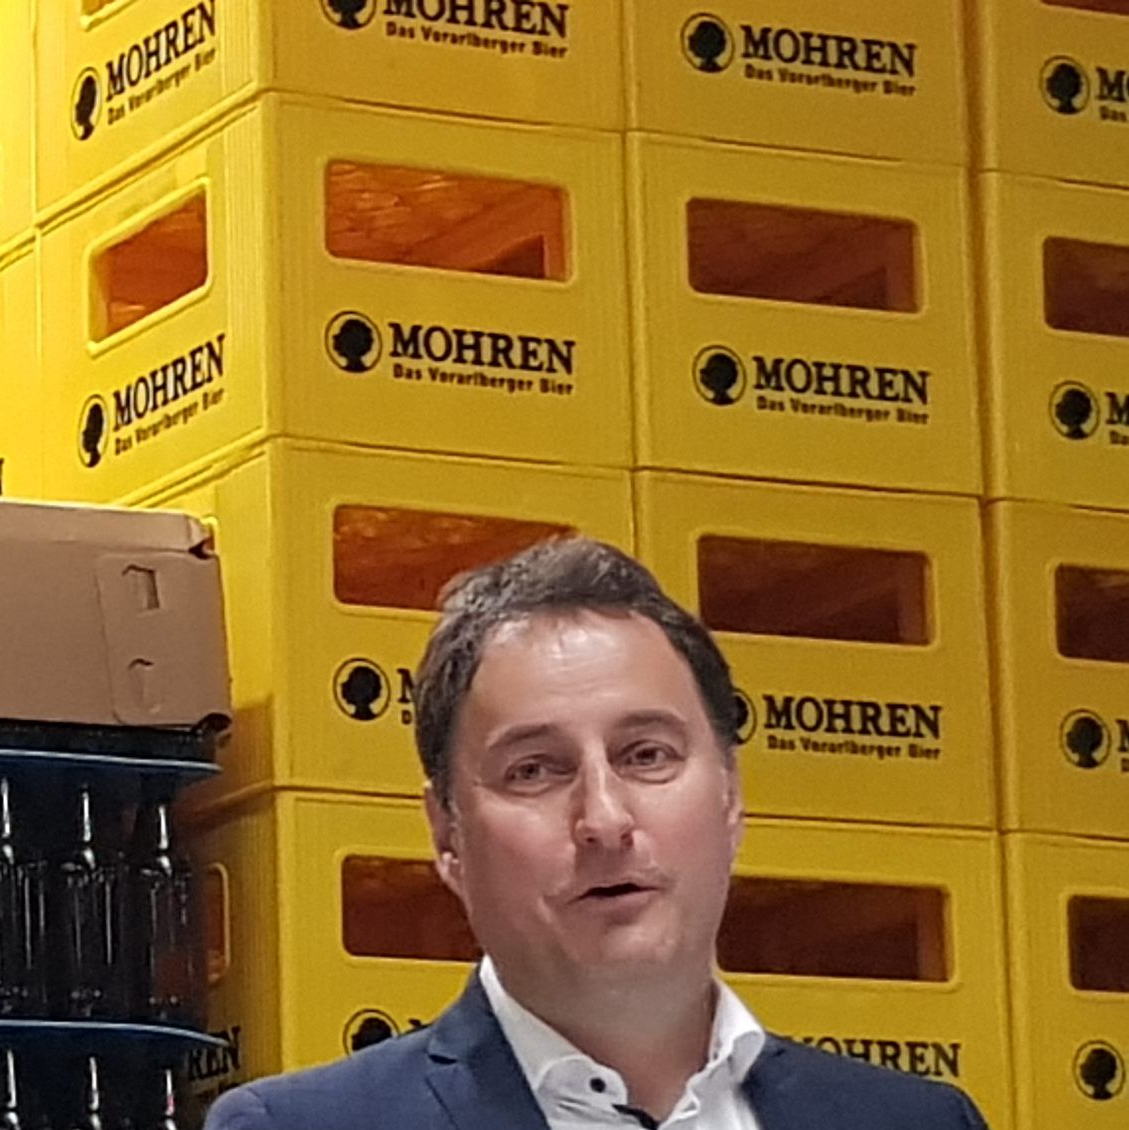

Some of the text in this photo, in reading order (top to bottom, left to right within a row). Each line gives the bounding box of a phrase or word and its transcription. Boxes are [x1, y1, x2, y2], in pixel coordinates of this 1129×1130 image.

[105, 0, 216, 102] MOHREN
[386, 21, 415, 38] Das
[532, 40, 567, 58] Bier
[739, 24, 917, 77] MOHREN
[388, 322, 576, 375] MOHREN
[113, 333, 225, 432] MOHREN
[393, 363, 422, 380] Das
[540, 378, 573, 395] Bier
[752, 355, 931, 405] MOHREN
[762, 694, 942, 739] MOHREN
